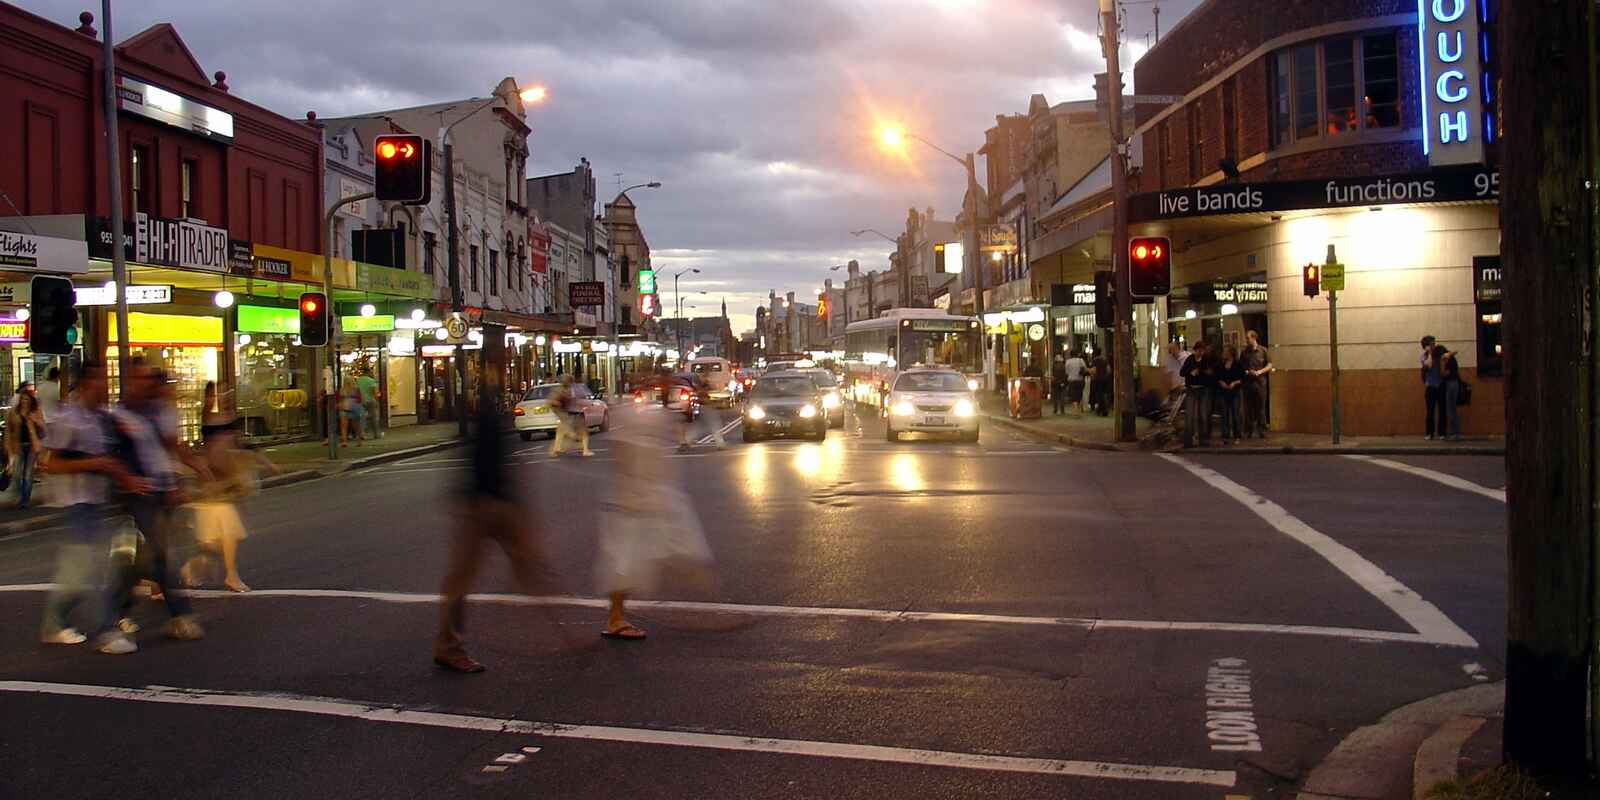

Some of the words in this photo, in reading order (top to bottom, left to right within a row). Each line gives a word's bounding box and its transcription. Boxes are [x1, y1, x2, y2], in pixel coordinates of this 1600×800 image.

[1159, 193, 1189, 215] live
[1197, 187, 1263, 211] bands
[1326, 178, 1435, 203] functions
[150, 219, 178, 261] HI-FI
[181, 225, 225, 268] TRADER
[451, 322, 464, 333] 60
[1205, 666, 1253, 707] RIGHT
[1205, 710, 1262, 751] LOOK
